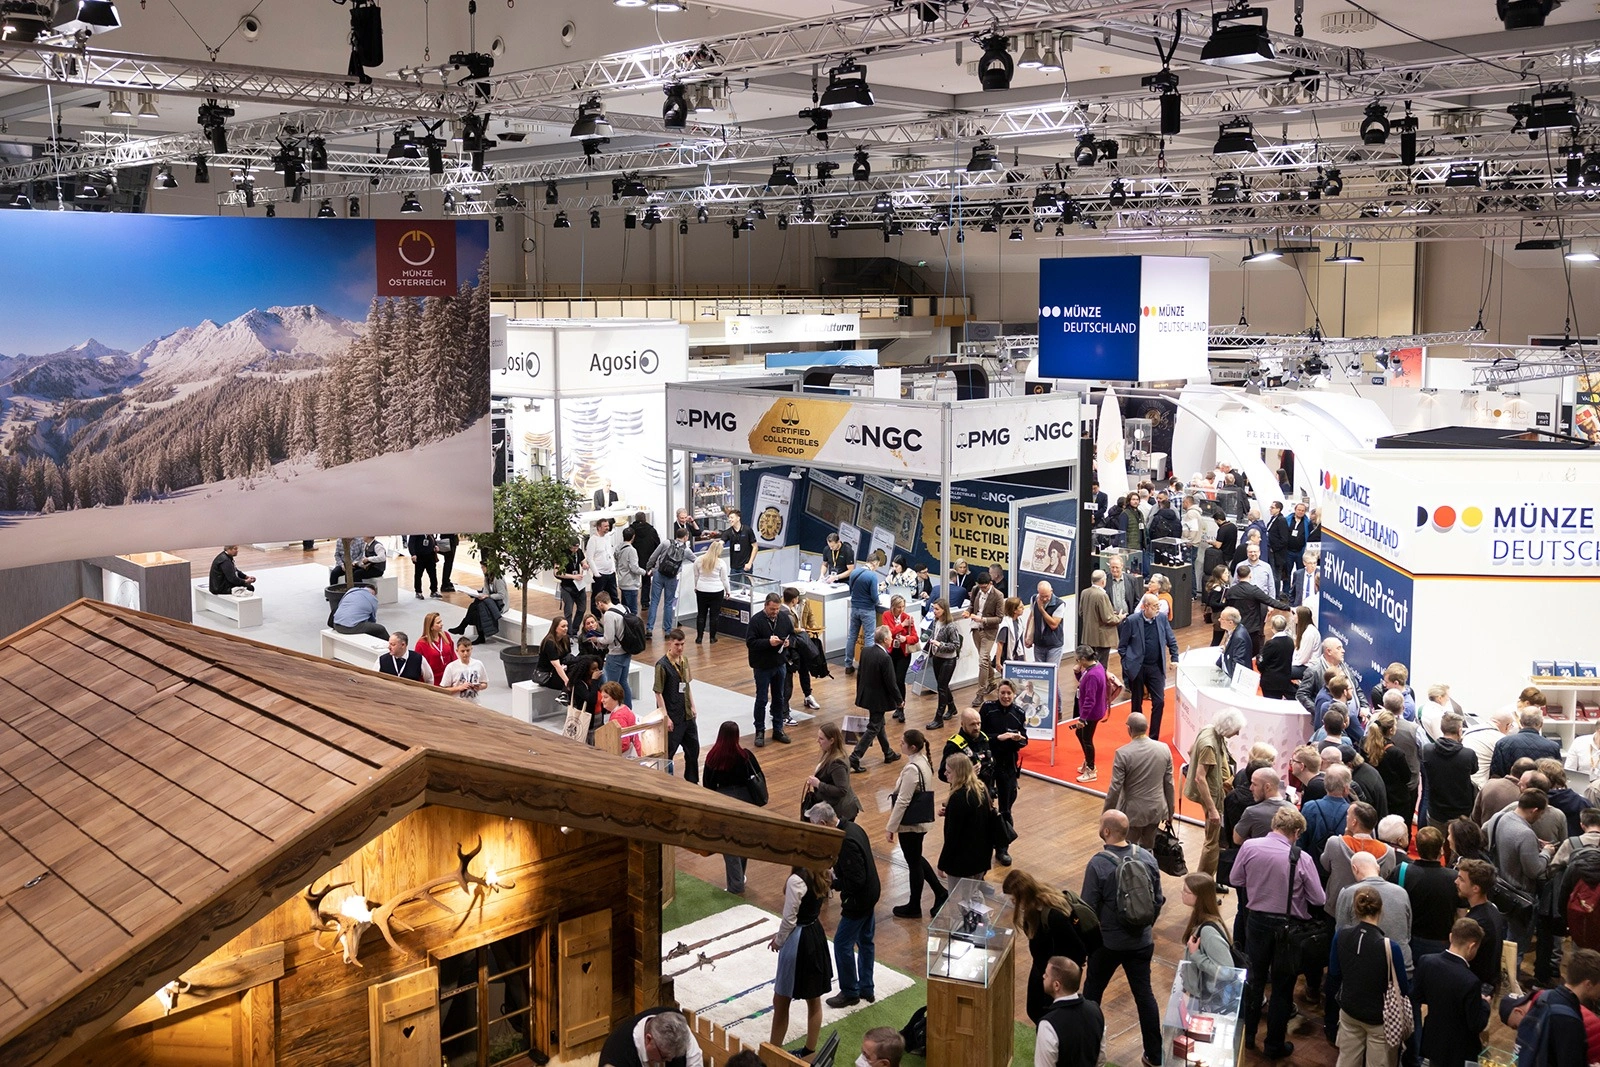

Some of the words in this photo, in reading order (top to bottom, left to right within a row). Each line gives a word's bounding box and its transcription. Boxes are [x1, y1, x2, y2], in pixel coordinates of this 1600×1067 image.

[402, 269, 433, 277] MÜNZE
[388, 278, 446, 286] ÖSTERREICH
[1063, 304, 1102, 318] MÜNZE
[1158, 304, 1185, 317] MÜNZE
[1063, 322, 1137, 334] DEUTSCHLAND
[1158, 321, 1207, 333] DEUTSCHLAND
[590, 350, 637, 376] Agosi
[688, 408, 737, 432] PMG
[771, 426, 811, 437] CERTIFIED
[861, 425, 923, 452] NGC
[968, 427, 1011, 449] PMG
[1035, 421, 1074, 442] NGC
[763, 435, 820, 448] COLLECTIBLES
[776, 445, 805, 455] GROUP
[988, 492, 1015, 503] NGC
[1340, 476, 1370, 507] MÜNZE
[935, 508, 973, 524] TUST
[1494, 503, 1594, 528] MÜNZE
[1339, 506, 1399, 549] DEUTSCHLAND
[955, 544, 977, 558] THE
[1323, 551, 1408, 633] #WasUnsPrägt
[1011, 667, 1049, 675] Signierstunde
